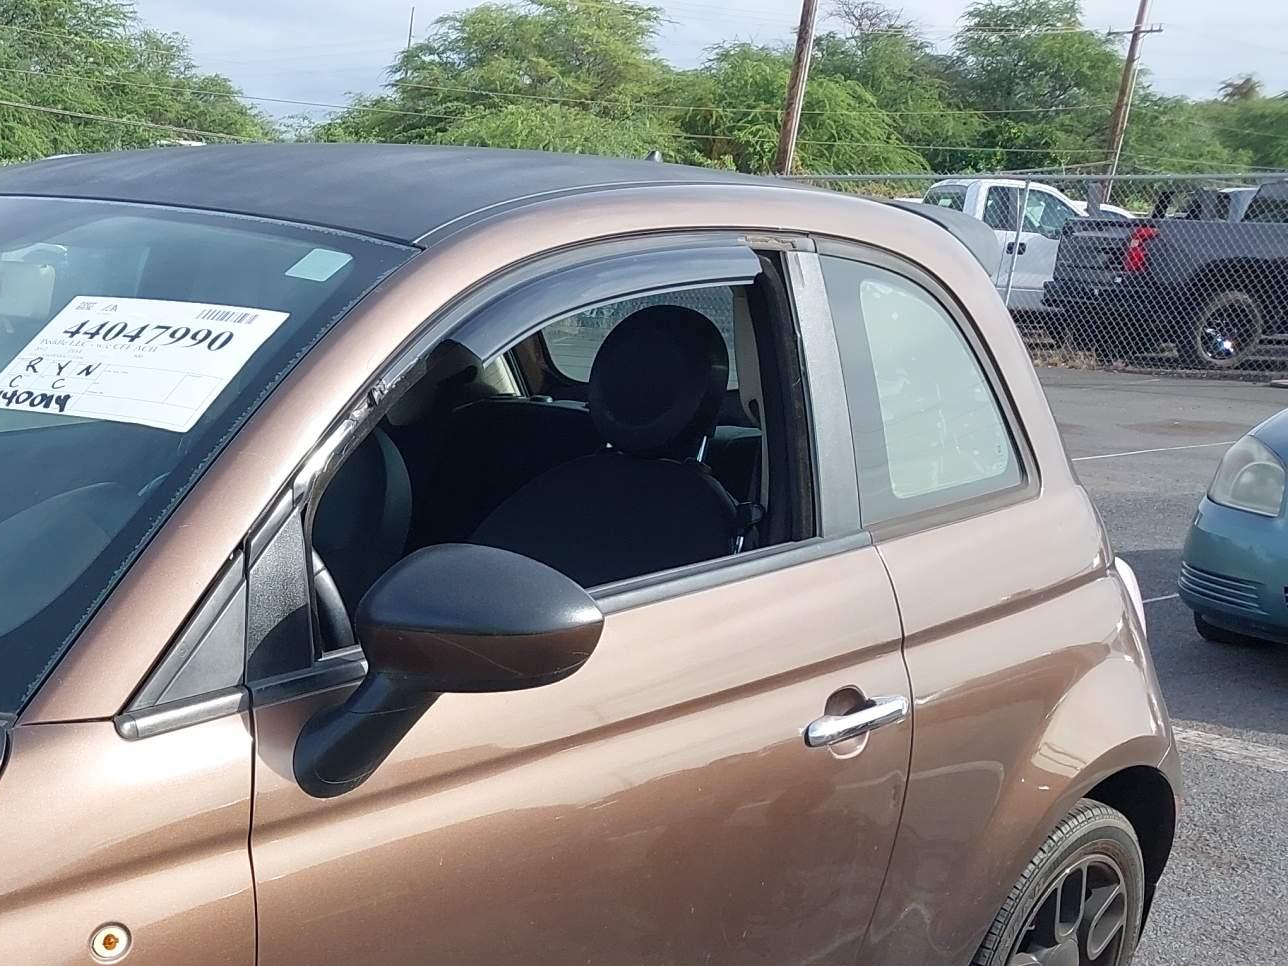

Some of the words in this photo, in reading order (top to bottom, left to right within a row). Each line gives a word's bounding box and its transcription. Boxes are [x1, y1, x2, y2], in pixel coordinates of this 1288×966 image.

[63, 320, 234, 351] 44047990
[26, 357, 43, 373] R
[56, 360, 72, 376] Y
[76, 362, 102, 376] N
[9, 375, 22, 387] C
[52, 379, 65, 389] C
